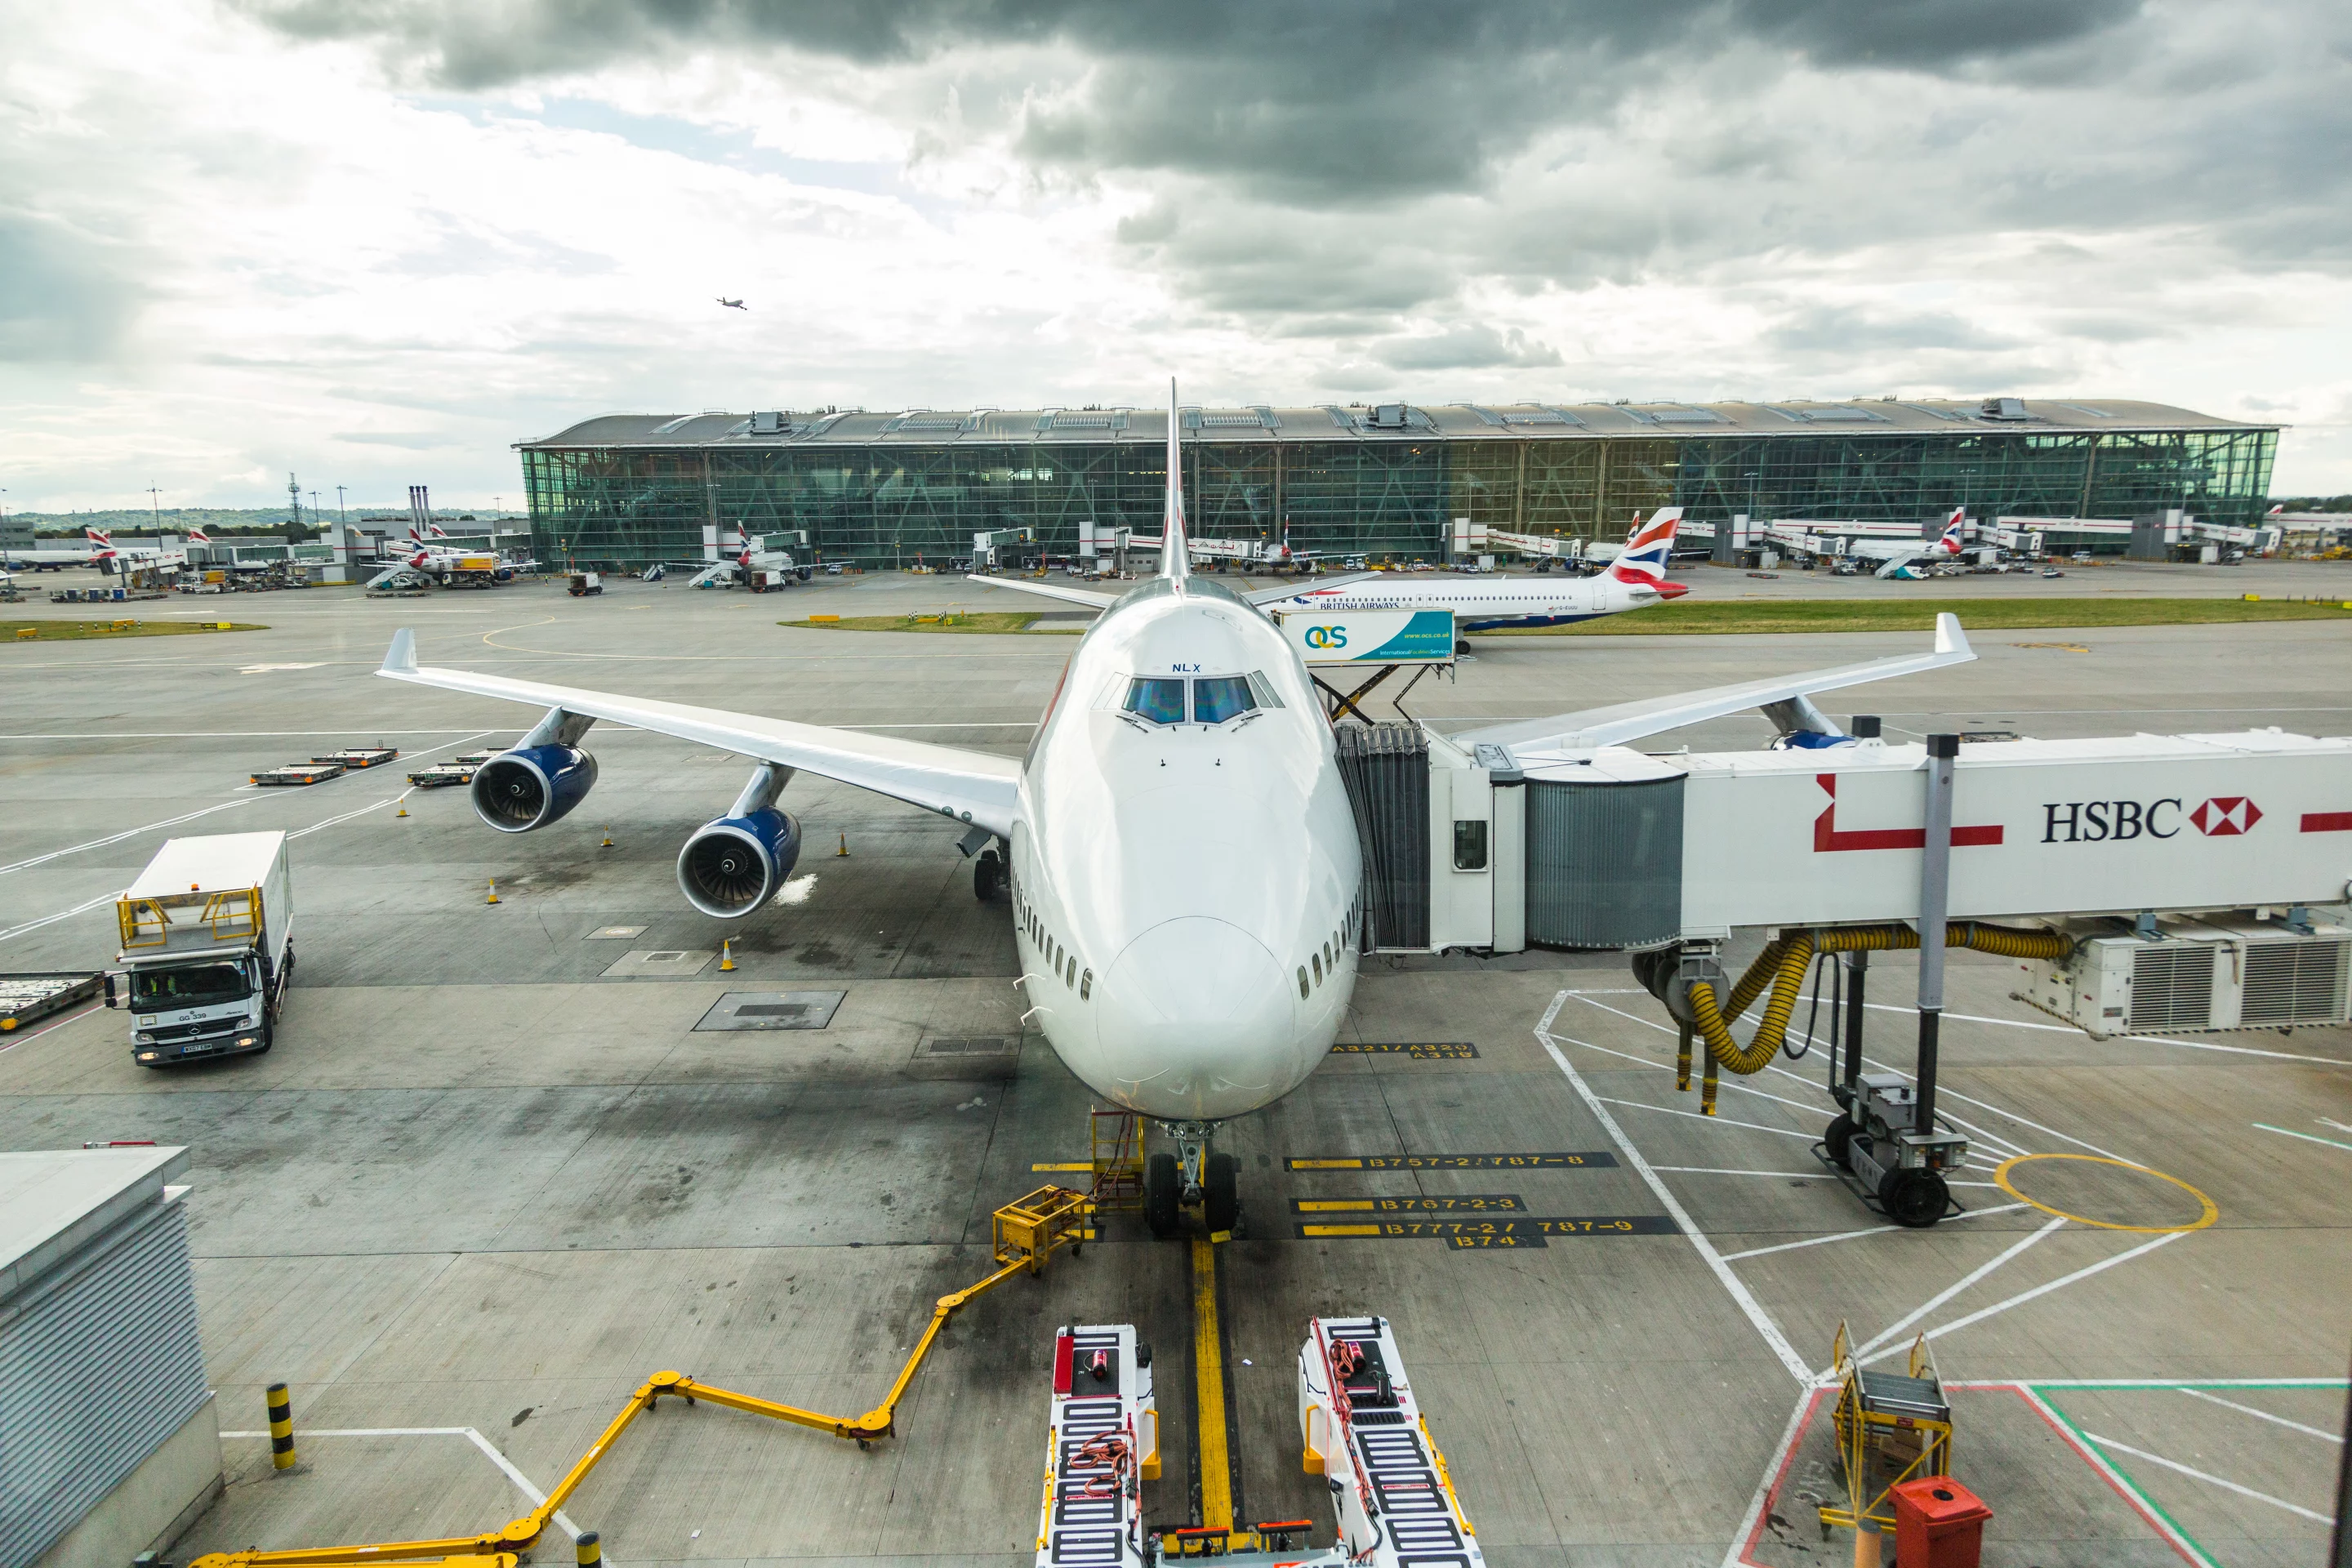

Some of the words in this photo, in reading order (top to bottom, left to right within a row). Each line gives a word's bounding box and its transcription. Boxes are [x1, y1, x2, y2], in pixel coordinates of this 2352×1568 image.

[1304, 626, 1348, 649] OCS
[1172, 663, 1200, 672] NLX
[2040, 798, 2181, 843] HSBC
[1381, 1198, 1516, 1211] B767-2-3
[1537, 1220, 1634, 1232] 787-9
[1456, 1235, 1517, 1247] B74
